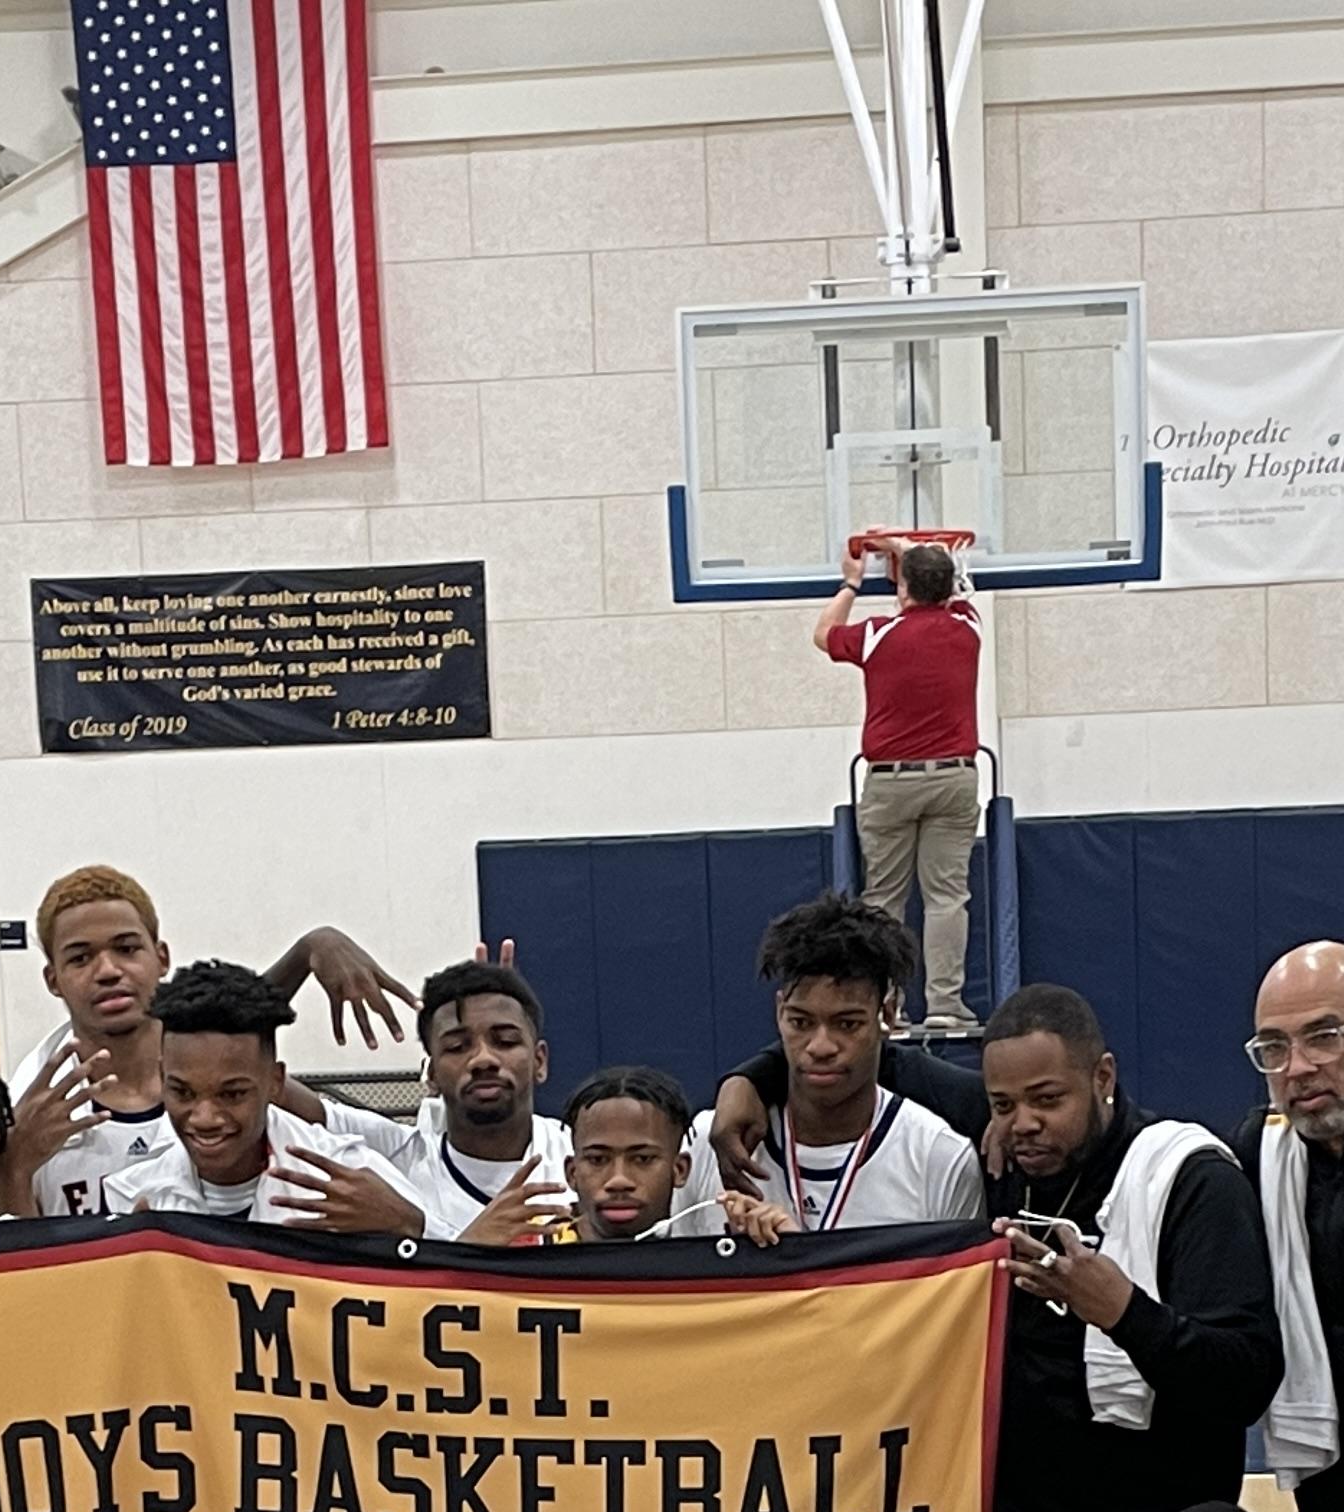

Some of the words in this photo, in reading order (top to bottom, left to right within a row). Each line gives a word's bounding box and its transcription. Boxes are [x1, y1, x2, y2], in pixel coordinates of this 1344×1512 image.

[1153, 417, 1291, 454] Orthopedic
[1161, 454, 1236, 488] ecialty
[40, 598, 91, 615] Above
[94, 596, 119, 614] all,
[122, 596, 160, 615] keep
[163, 594, 214, 611] loving
[216, 595, 246, 607] one
[248, 590, 311, 606] another
[314, 586, 392, 605] earnestly,
[395, 585, 435, 601] since
[439, 582, 473, 598] love
[60, 623, 111, 637] covers
[114, 623, 125, 635] a
[128, 617, 206, 634] multitude
[209, 615, 228, 631] of
[229, 615, 265, 631] sins.
[267, 612, 312, 628] Show
[315, 609, 401, 629] hospitality
[404, 609, 421, 623] to
[424, 608, 454, 622] one
[42, 644, 104, 661] another
[107, 642, 168, 658] without
[171, 638, 260, 660] grumbling,
[262, 637, 284, 652] As
[286, 634, 324, 651] each
[327, 634, 355, 650] has
[358, 630, 424, 649] received
[428, 632, 439, 645] a
[442, 628, 475, 649] gift,
[77, 669, 104, 683] use
[107, 665, 119, 681] it
[122, 666, 138, 680] to
[141, 666, 184, 680] serve
[186, 665, 216, 679] one
[219, 660, 285, 677] another,
[287, 662, 305, 675] as
[308, 657, 348, 678] good
[351, 654, 422, 672] stewards
[424, 652, 444, 670] of
[182, 685, 231, 702] God's
[234, 683, 286, 700] varied
[287, 684, 337, 702] grace.
[69, 715, 116, 739] Class
[119, 714, 143, 742] of
[143, 715, 188, 736] 2019
[332, 711, 342, 730] 1
[345, 709, 395, 729] Peter
[397, 706, 457, 727] 4:8-10
[227, 1282, 610, 1417] M.C.S.T.
